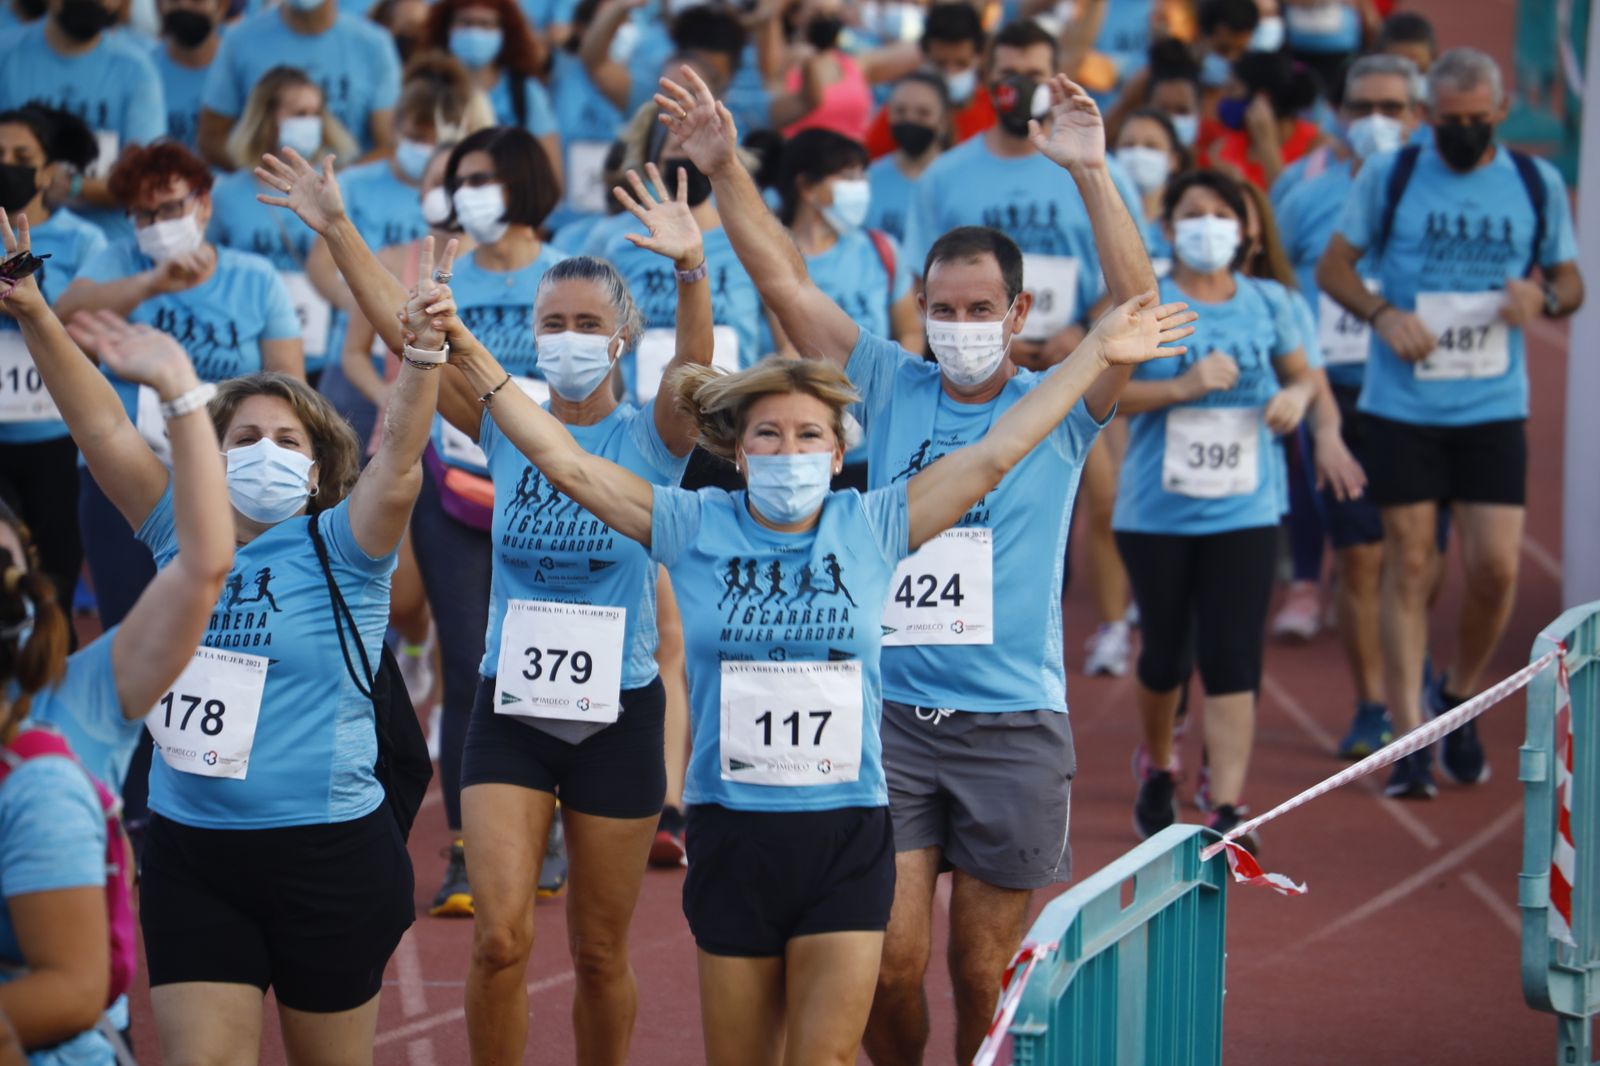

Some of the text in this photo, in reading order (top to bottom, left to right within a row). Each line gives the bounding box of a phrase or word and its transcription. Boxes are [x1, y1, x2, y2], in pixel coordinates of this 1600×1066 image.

[1438, 325, 1491, 351] 487
[0, 366, 43, 394] 10
[1187, 442, 1241, 469] 398
[531, 519, 610, 537] CARRERA
[502, 534, 543, 551] MUJER
[894, 573, 965, 609] 424
[209, 611, 268, 631] RRERA
[760, 607, 850, 626] CARRERA
[719, 626, 775, 643] MUJER
[217, 654, 245, 665] MUJER
[245, 659, 262, 669] 2021
[522, 647, 593, 684] 379
[160, 691, 226, 736] 178
[755, 710, 833, 747] 117
